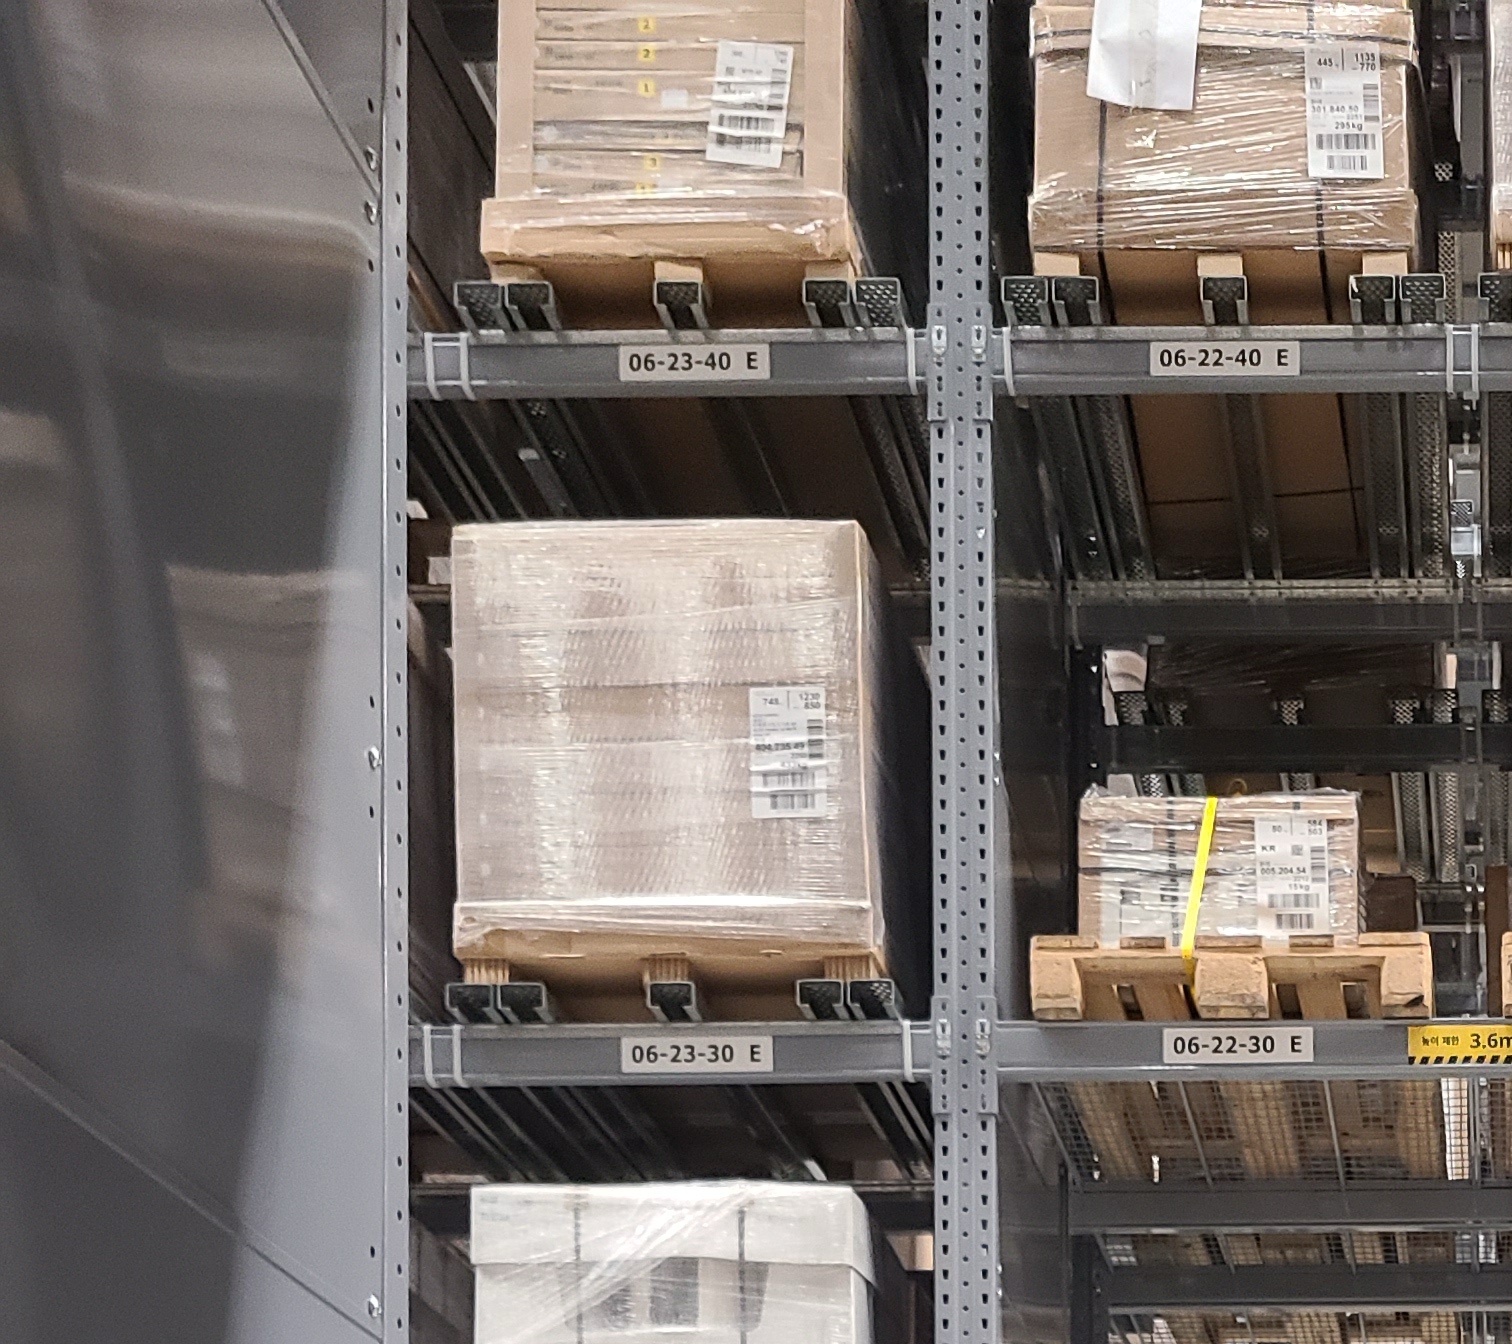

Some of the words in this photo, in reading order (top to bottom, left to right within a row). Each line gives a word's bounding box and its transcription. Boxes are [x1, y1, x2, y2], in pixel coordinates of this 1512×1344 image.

[1359, 63, 1376, 71] 770
[628, 352, 732, 374] 06-23-40
[746, 352, 759, 371] E
[1159, 348, 1262, 368] 06-22-40
[1276, 349, 1289, 367] E
[630, 1044, 735, 1064] 06-23-30
[749, 1045, 762, 1062] E
[1173, 1035, 1276, 1055] 06-22-30
[1290, 1035, 1303, 1053] E
